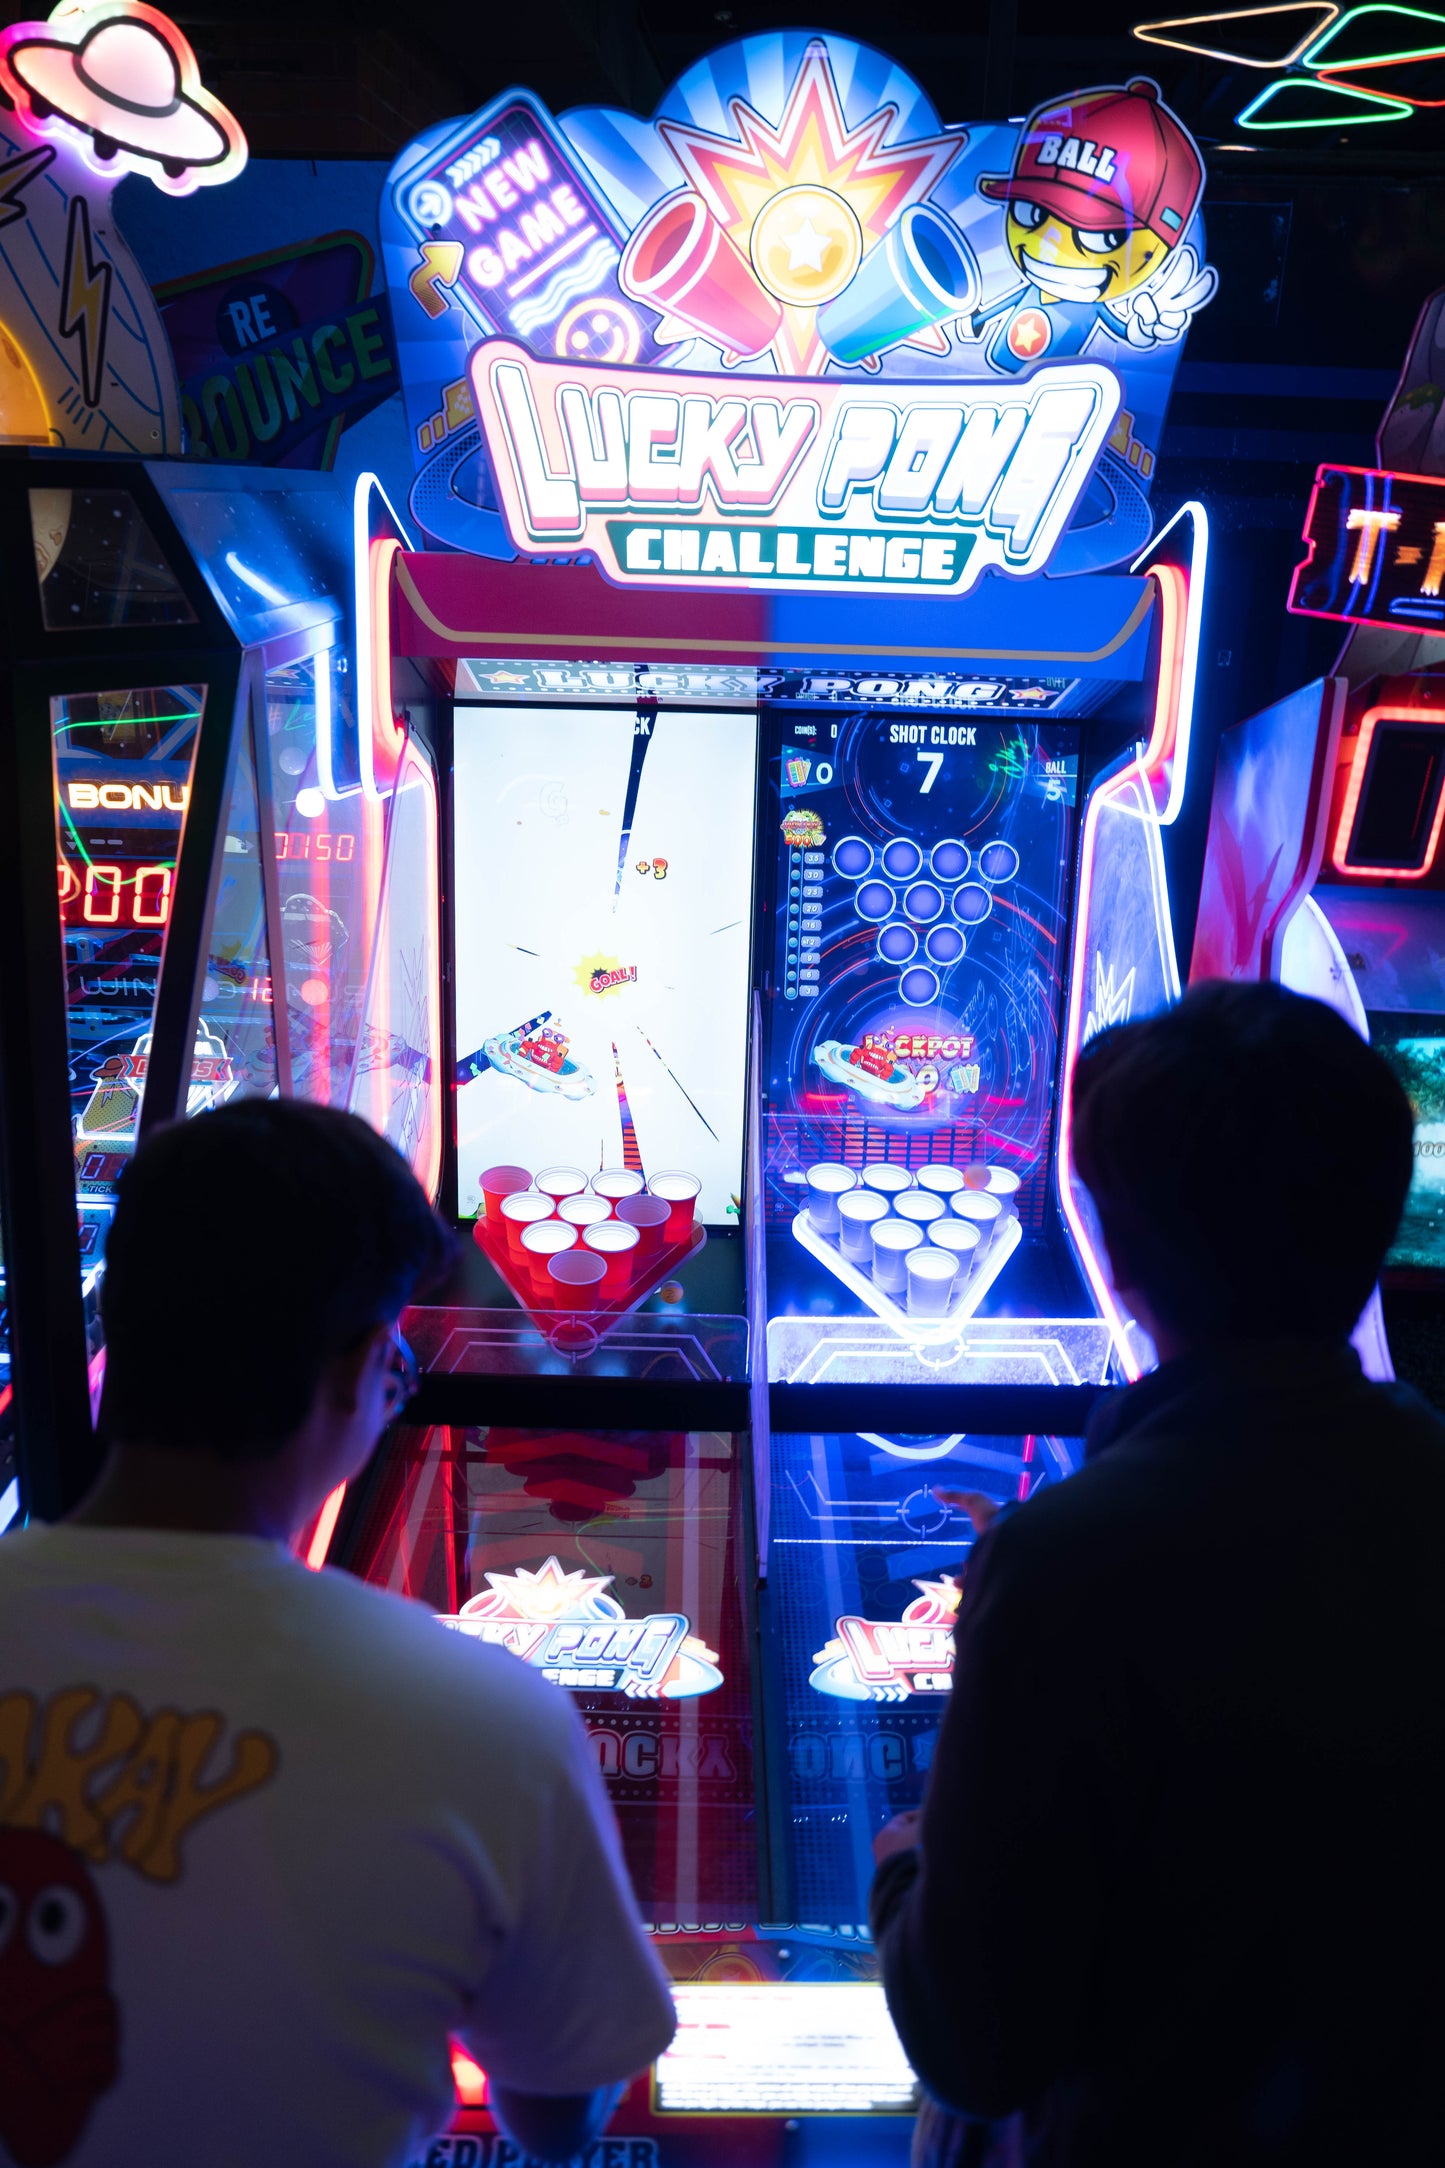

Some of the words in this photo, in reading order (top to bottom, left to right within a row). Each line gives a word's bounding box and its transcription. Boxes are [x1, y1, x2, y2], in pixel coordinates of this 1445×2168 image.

[1035, 135, 1118, 184] BALL
[454, 138, 551, 233] NEW
[467, 184, 587, 287] GAME
[228, 293, 277, 348] RE
[495, 361, 816, 532] LUCKY
[827, 387, 1096, 556] PONG
[625, 529, 957, 580] CHALLENGE
[536, 669, 784, 695] LUCKY
[802, 675, 1005, 700] PONG
[889, 724, 928, 744] SHOT
[931, 726, 977, 746] CLOCK
[816, 762, 834, 784] 0
[917, 751, 944, 794] 7
[1045, 760, 1067, 774] BALL
[67, 782, 190, 812] BONU
[1046, 779, 1062, 801] 5
[636, 858, 668, 880] +3
[806, 905, 818, 913] 20
[590, 965, 638, 993] GOAL!
[88, 1185, 113, 1193] TICK
[546, 1620, 678, 1679] PONG
[845, 1618, 957, 1679] LUCK
